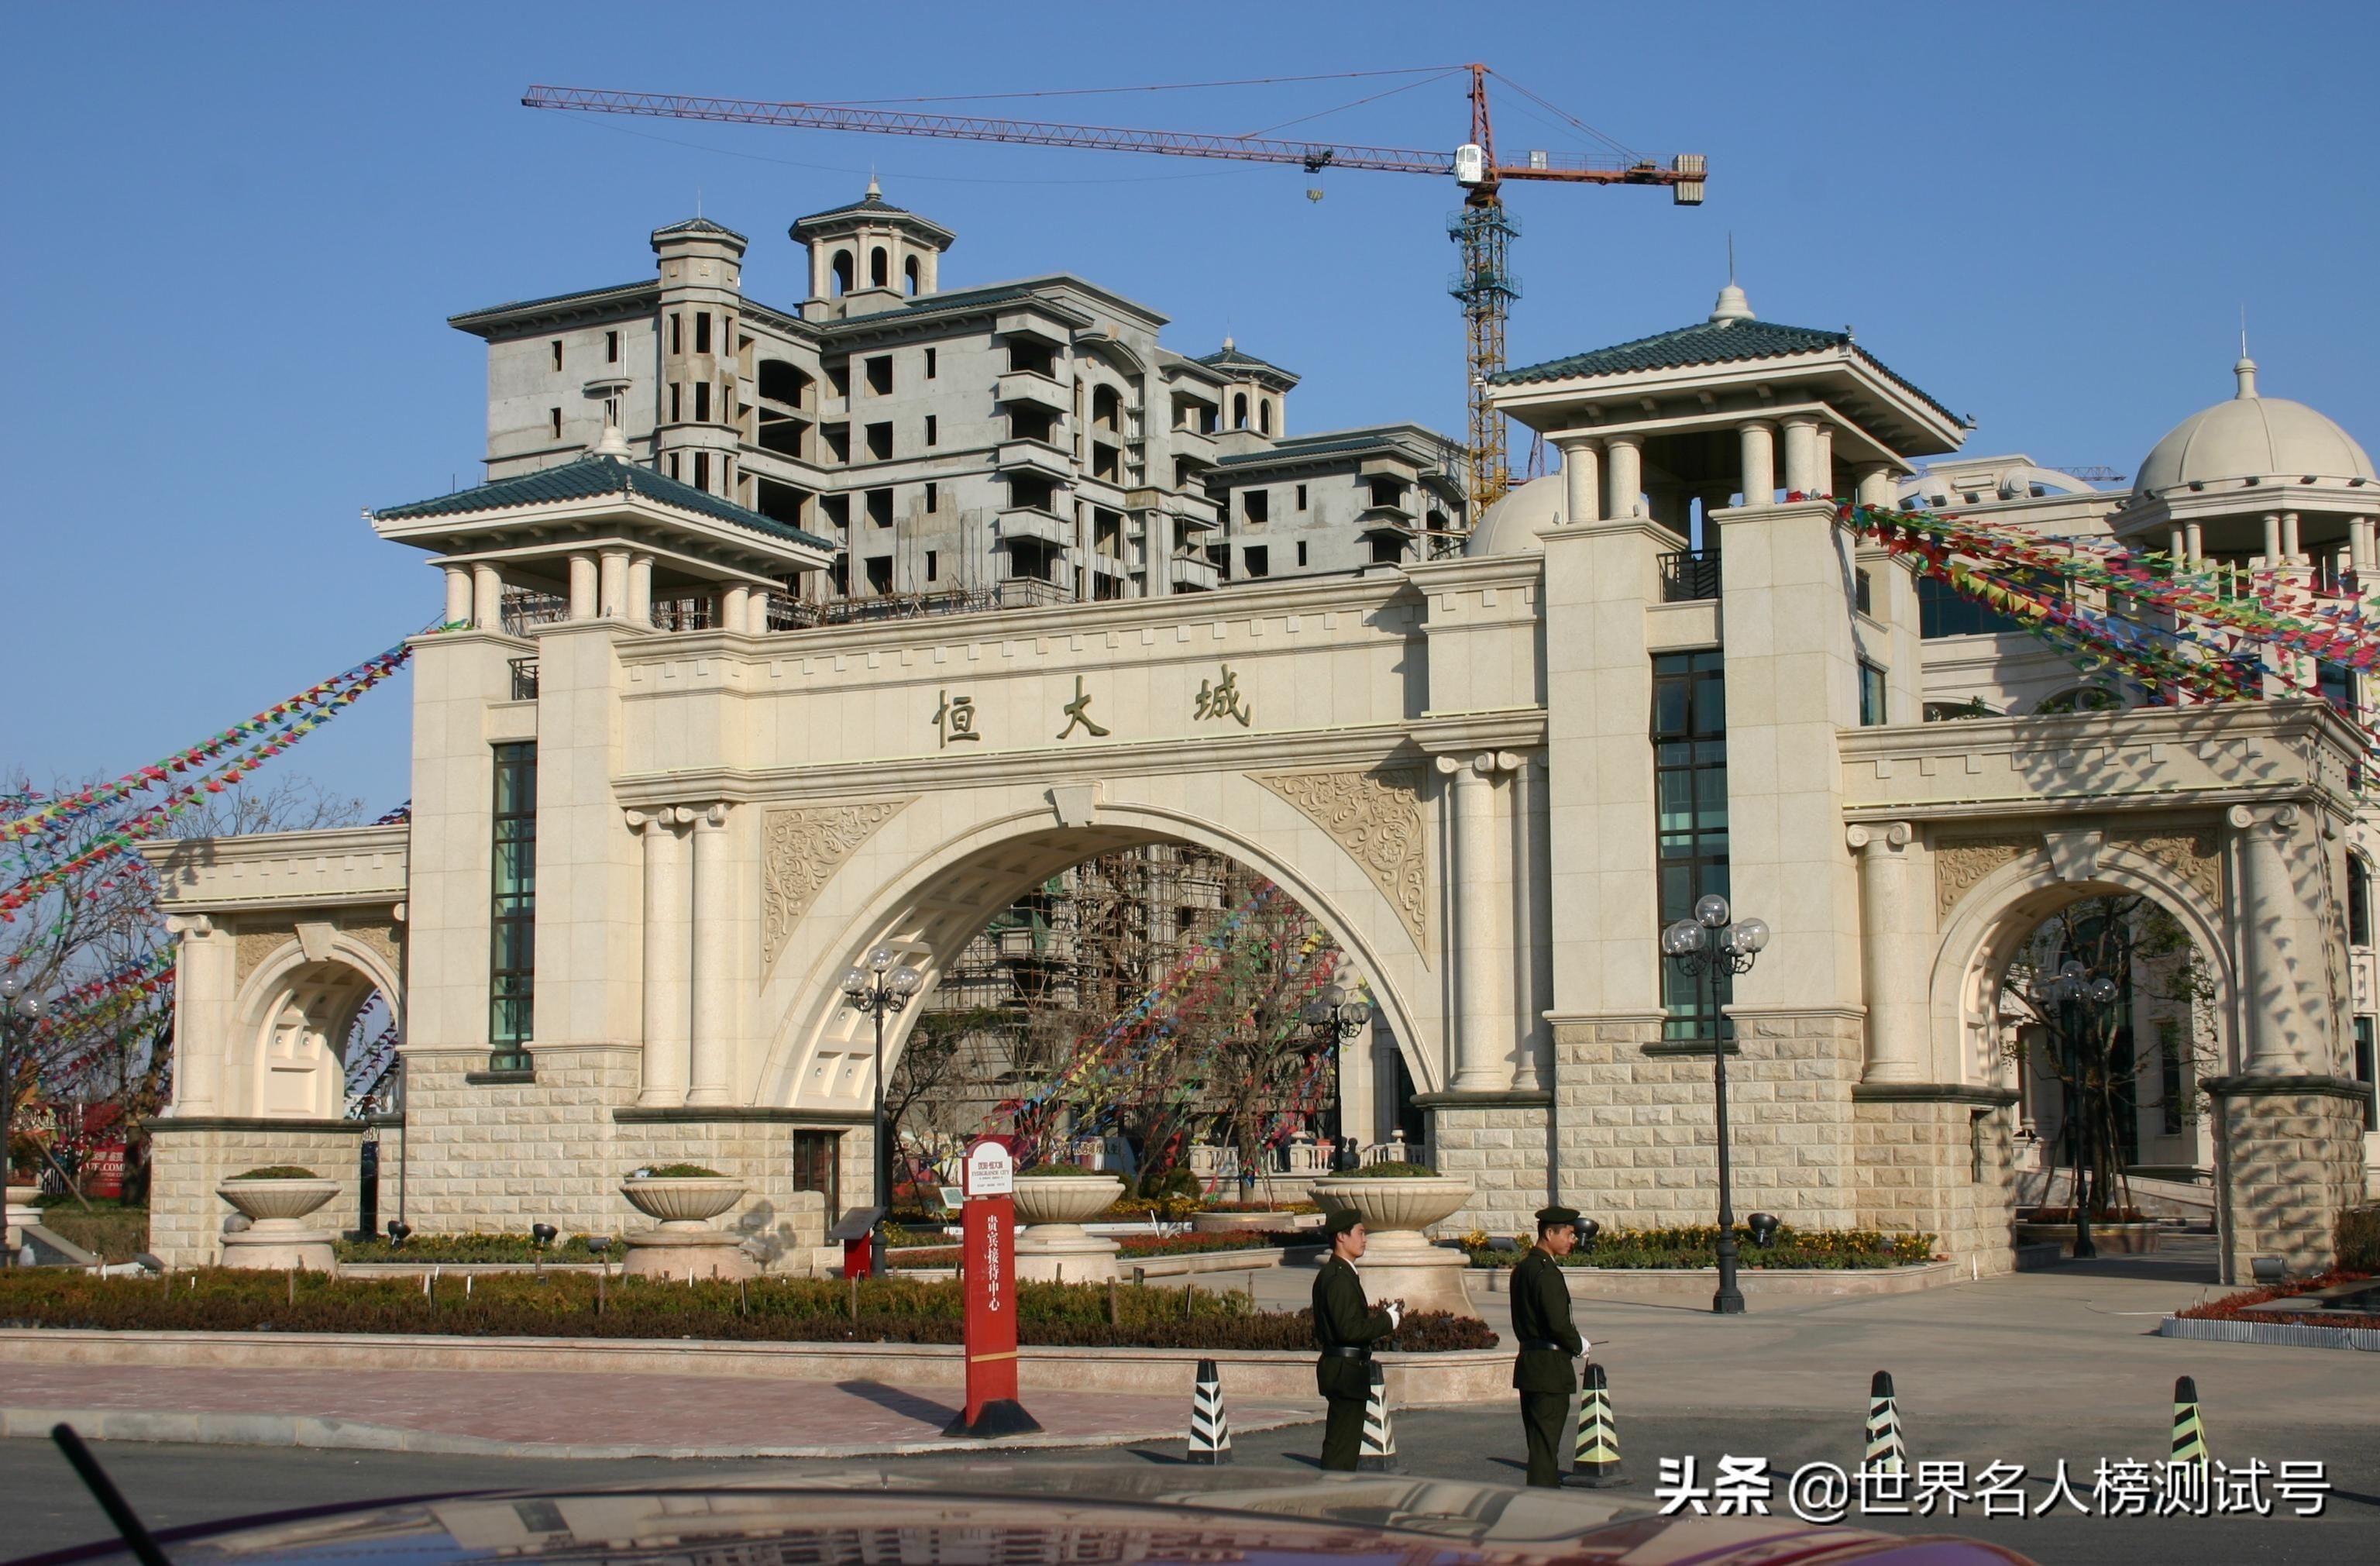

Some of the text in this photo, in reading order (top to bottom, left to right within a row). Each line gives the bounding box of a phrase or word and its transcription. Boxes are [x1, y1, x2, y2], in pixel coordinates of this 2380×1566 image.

[931, 663, 1252, 750] 恒大城
[987, 1214, 1000, 1311] 贵宾接待中心
